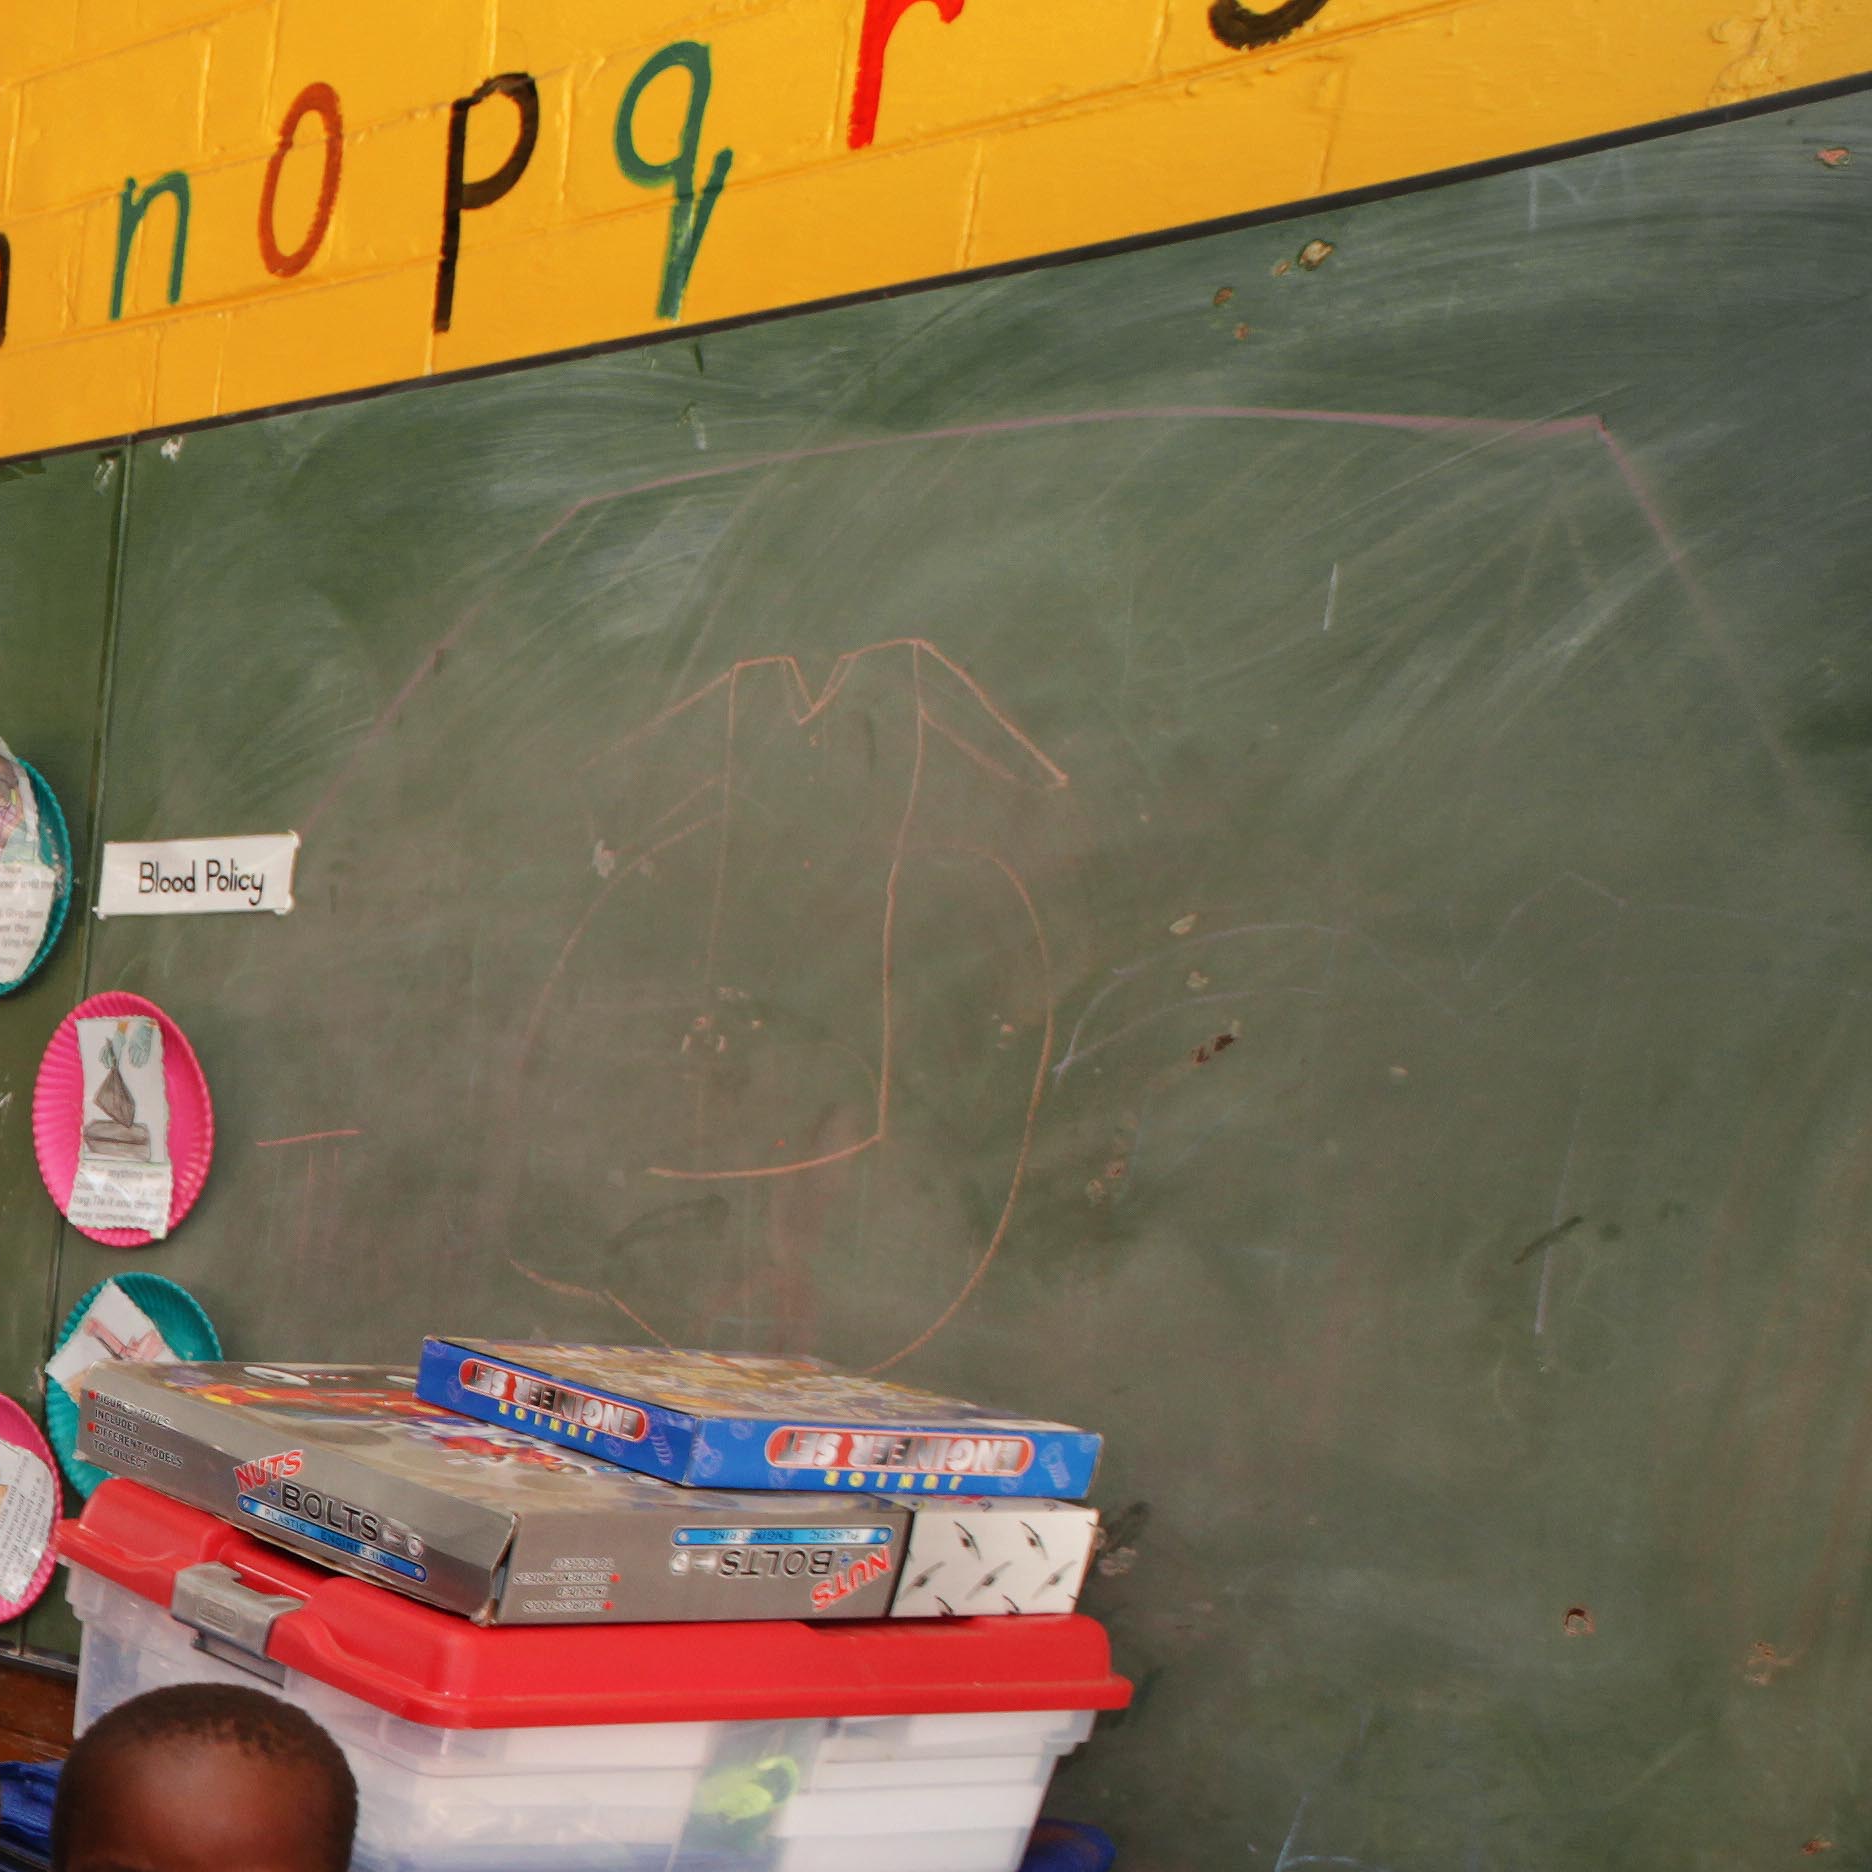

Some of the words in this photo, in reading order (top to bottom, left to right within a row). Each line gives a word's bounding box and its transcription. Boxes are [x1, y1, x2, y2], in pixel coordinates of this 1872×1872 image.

[108, 168, 192, 321] n
[258, 81, 344, 279] o
[432, 72, 541, 334] p
[613, 39, 734, 323] q
[138, 859, 196, 894] Blood
[206, 857, 265, 906] Policy
[497, 1400, 598, 1443] JUNIOR
[512, 1375, 640, 1437] ENGINEER
[232, 1449, 304, 1493] NUTS
[848, 1434, 1024, 1473] ENGINEER
[823, 1470, 964, 1491] JUNIOR
[281, 1480, 379, 1542] BOLTS
[718, 1548, 836, 1577] BOLTS
[809, 1546, 893, 1611] NUTS
